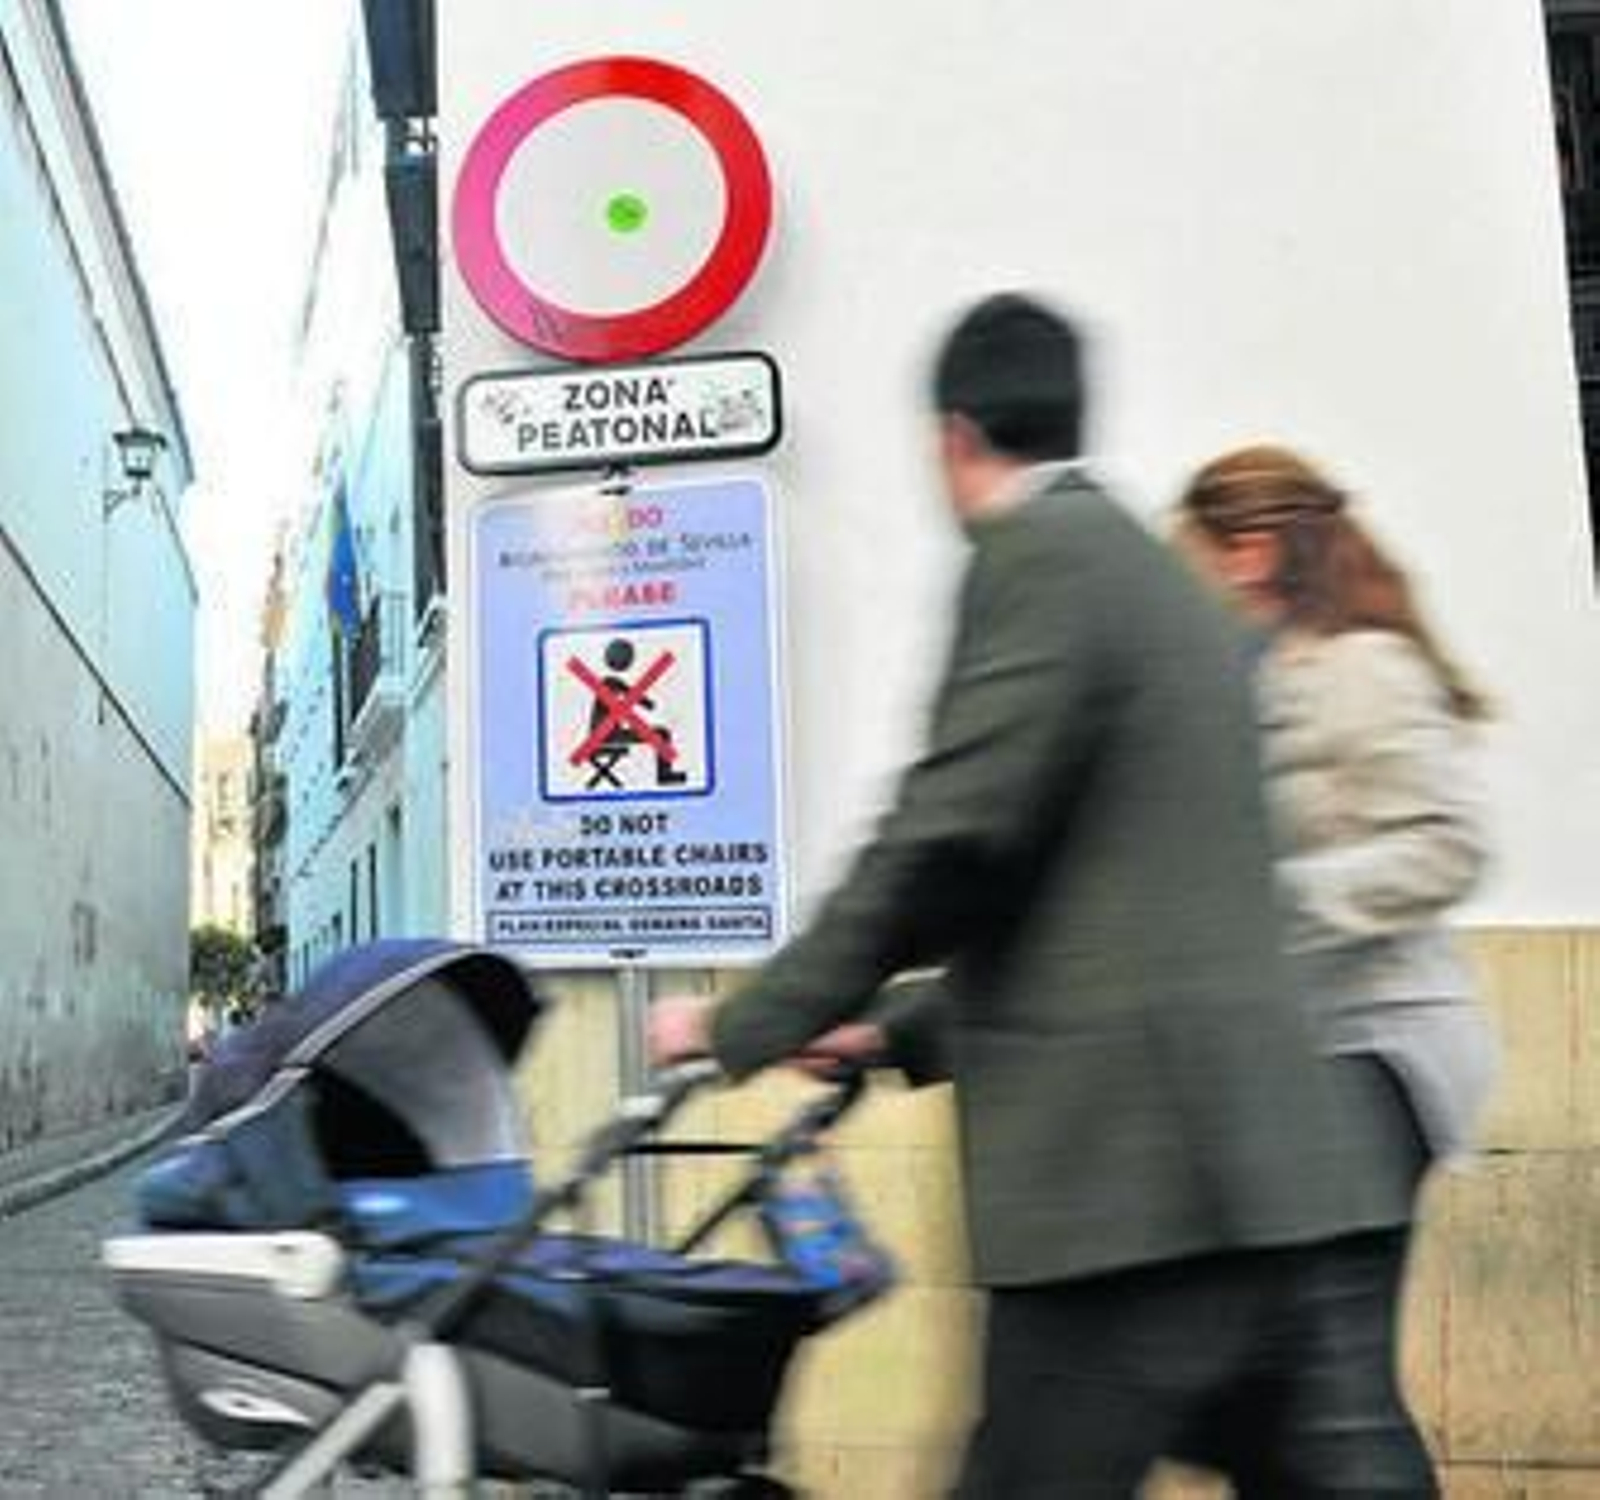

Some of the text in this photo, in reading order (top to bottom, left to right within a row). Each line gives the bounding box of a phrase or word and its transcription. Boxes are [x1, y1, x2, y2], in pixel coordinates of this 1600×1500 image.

[562, 377, 670, 411] ZONA
[517, 411, 718, 452] PEATONAL
[569, 581, 677, 610] EASE
[579, 813, 669, 836] DO NOT
[488, 842, 769, 872] USE PORTABLE CHAIRS
[494, 873, 764, 902] AT THIS CROSSROADS
